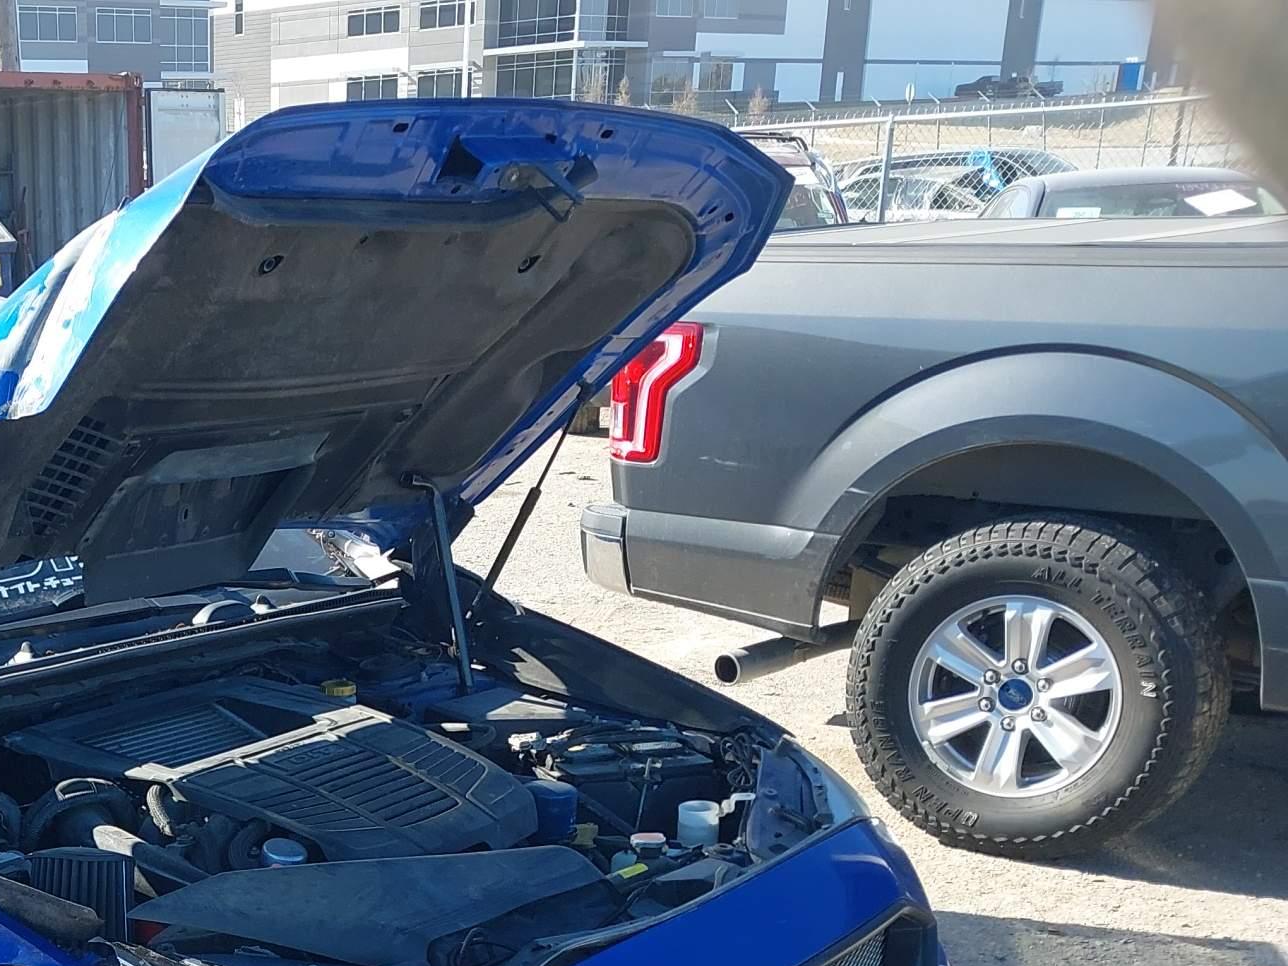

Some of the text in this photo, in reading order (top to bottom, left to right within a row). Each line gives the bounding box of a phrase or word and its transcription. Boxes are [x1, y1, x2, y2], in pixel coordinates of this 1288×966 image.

[1031, 566, 1159, 698] ALL TERRAIN
[870, 700, 980, 828] OPEN RANGE
